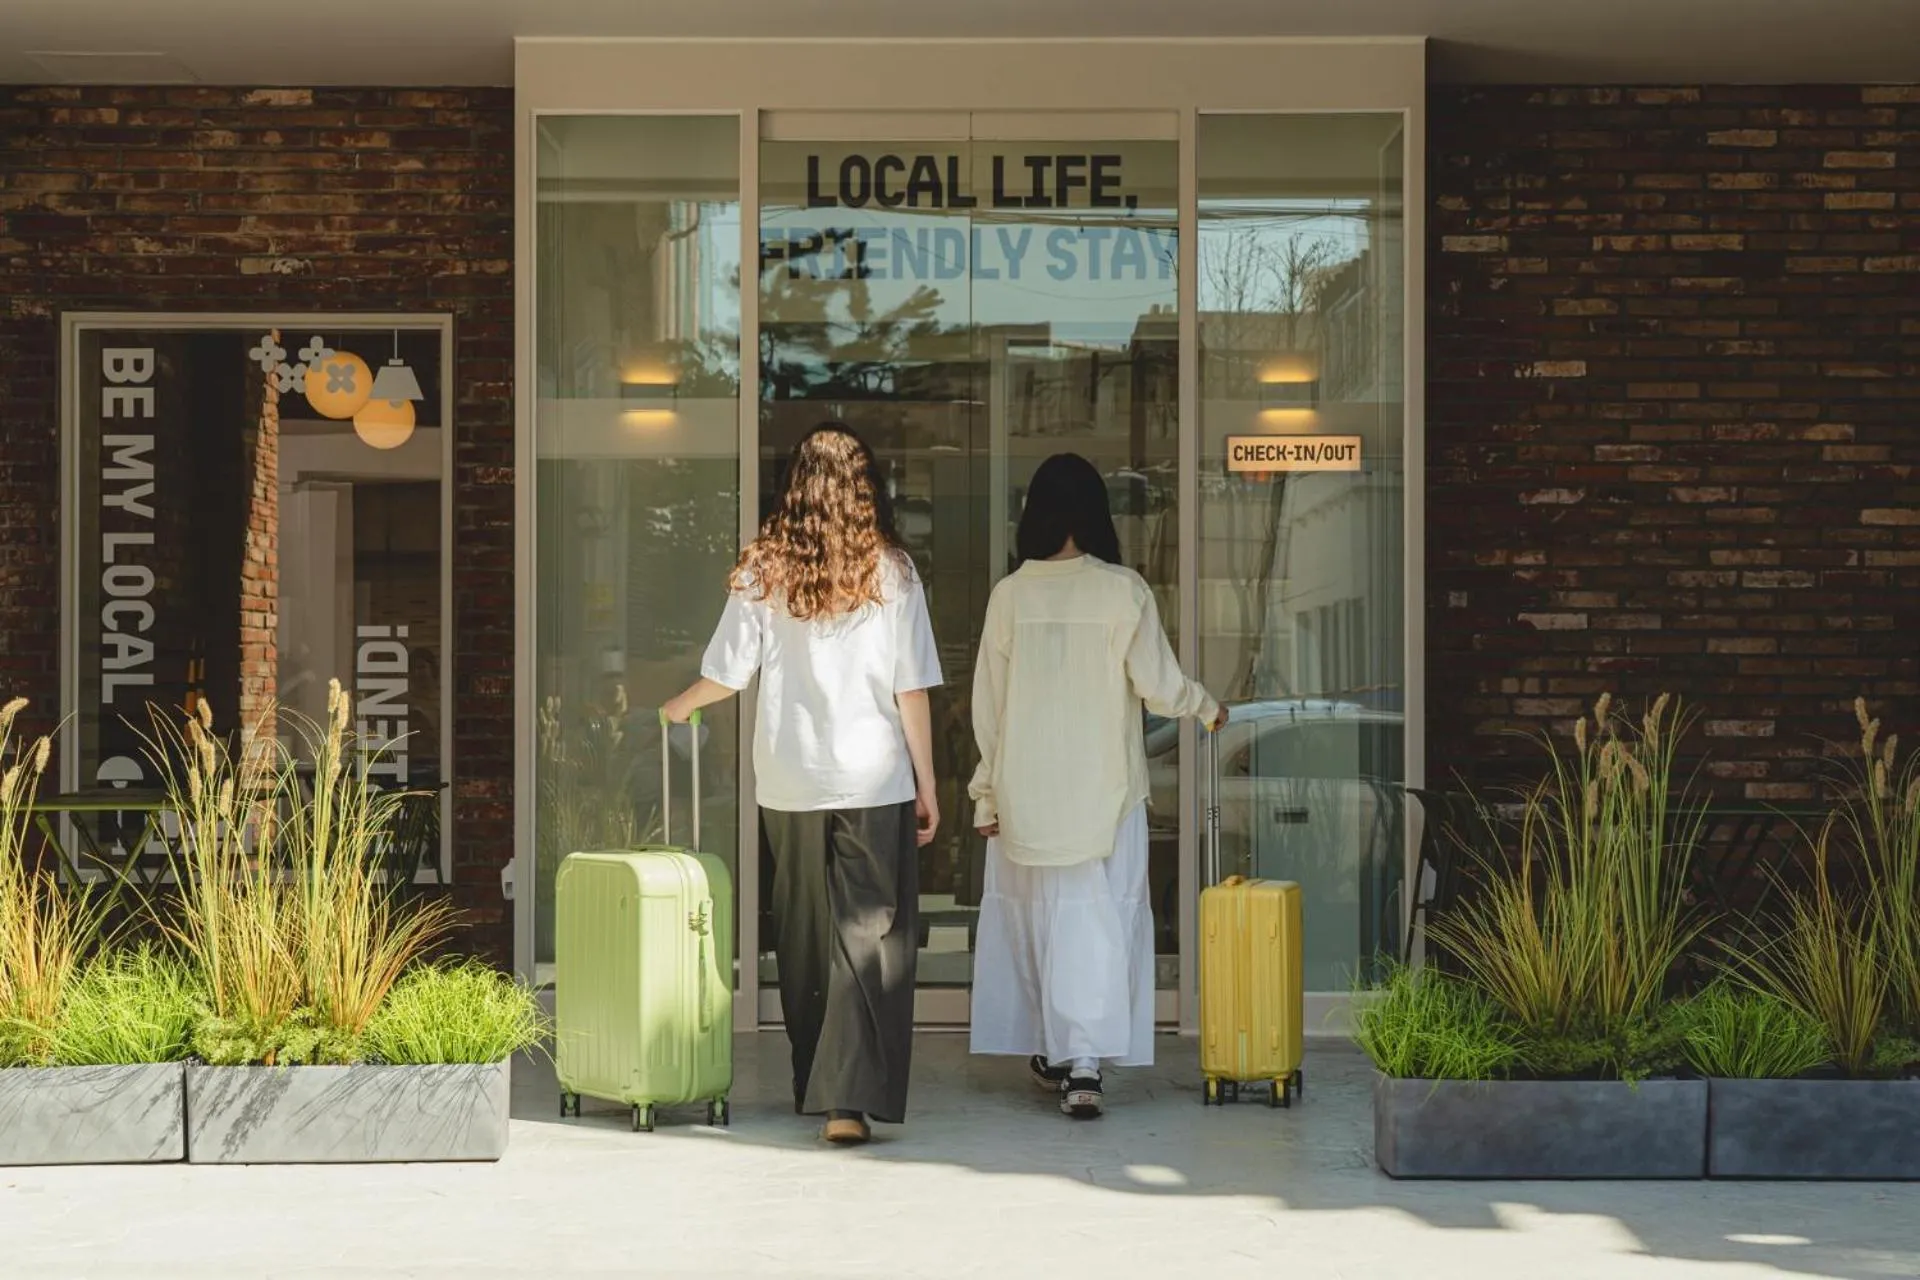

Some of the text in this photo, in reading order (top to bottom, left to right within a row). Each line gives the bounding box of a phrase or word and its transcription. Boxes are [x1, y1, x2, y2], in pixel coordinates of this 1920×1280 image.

[807, 155, 1137, 217] LOCAL LIFE,
[759, 227, 1180, 280] FRIENDLY STAY
[1233, 443, 1355, 463] CHECK-IN/OUT
[101, 348, 155, 703] BE MY LOCAL
[357, 625, 408, 854] IEND!
